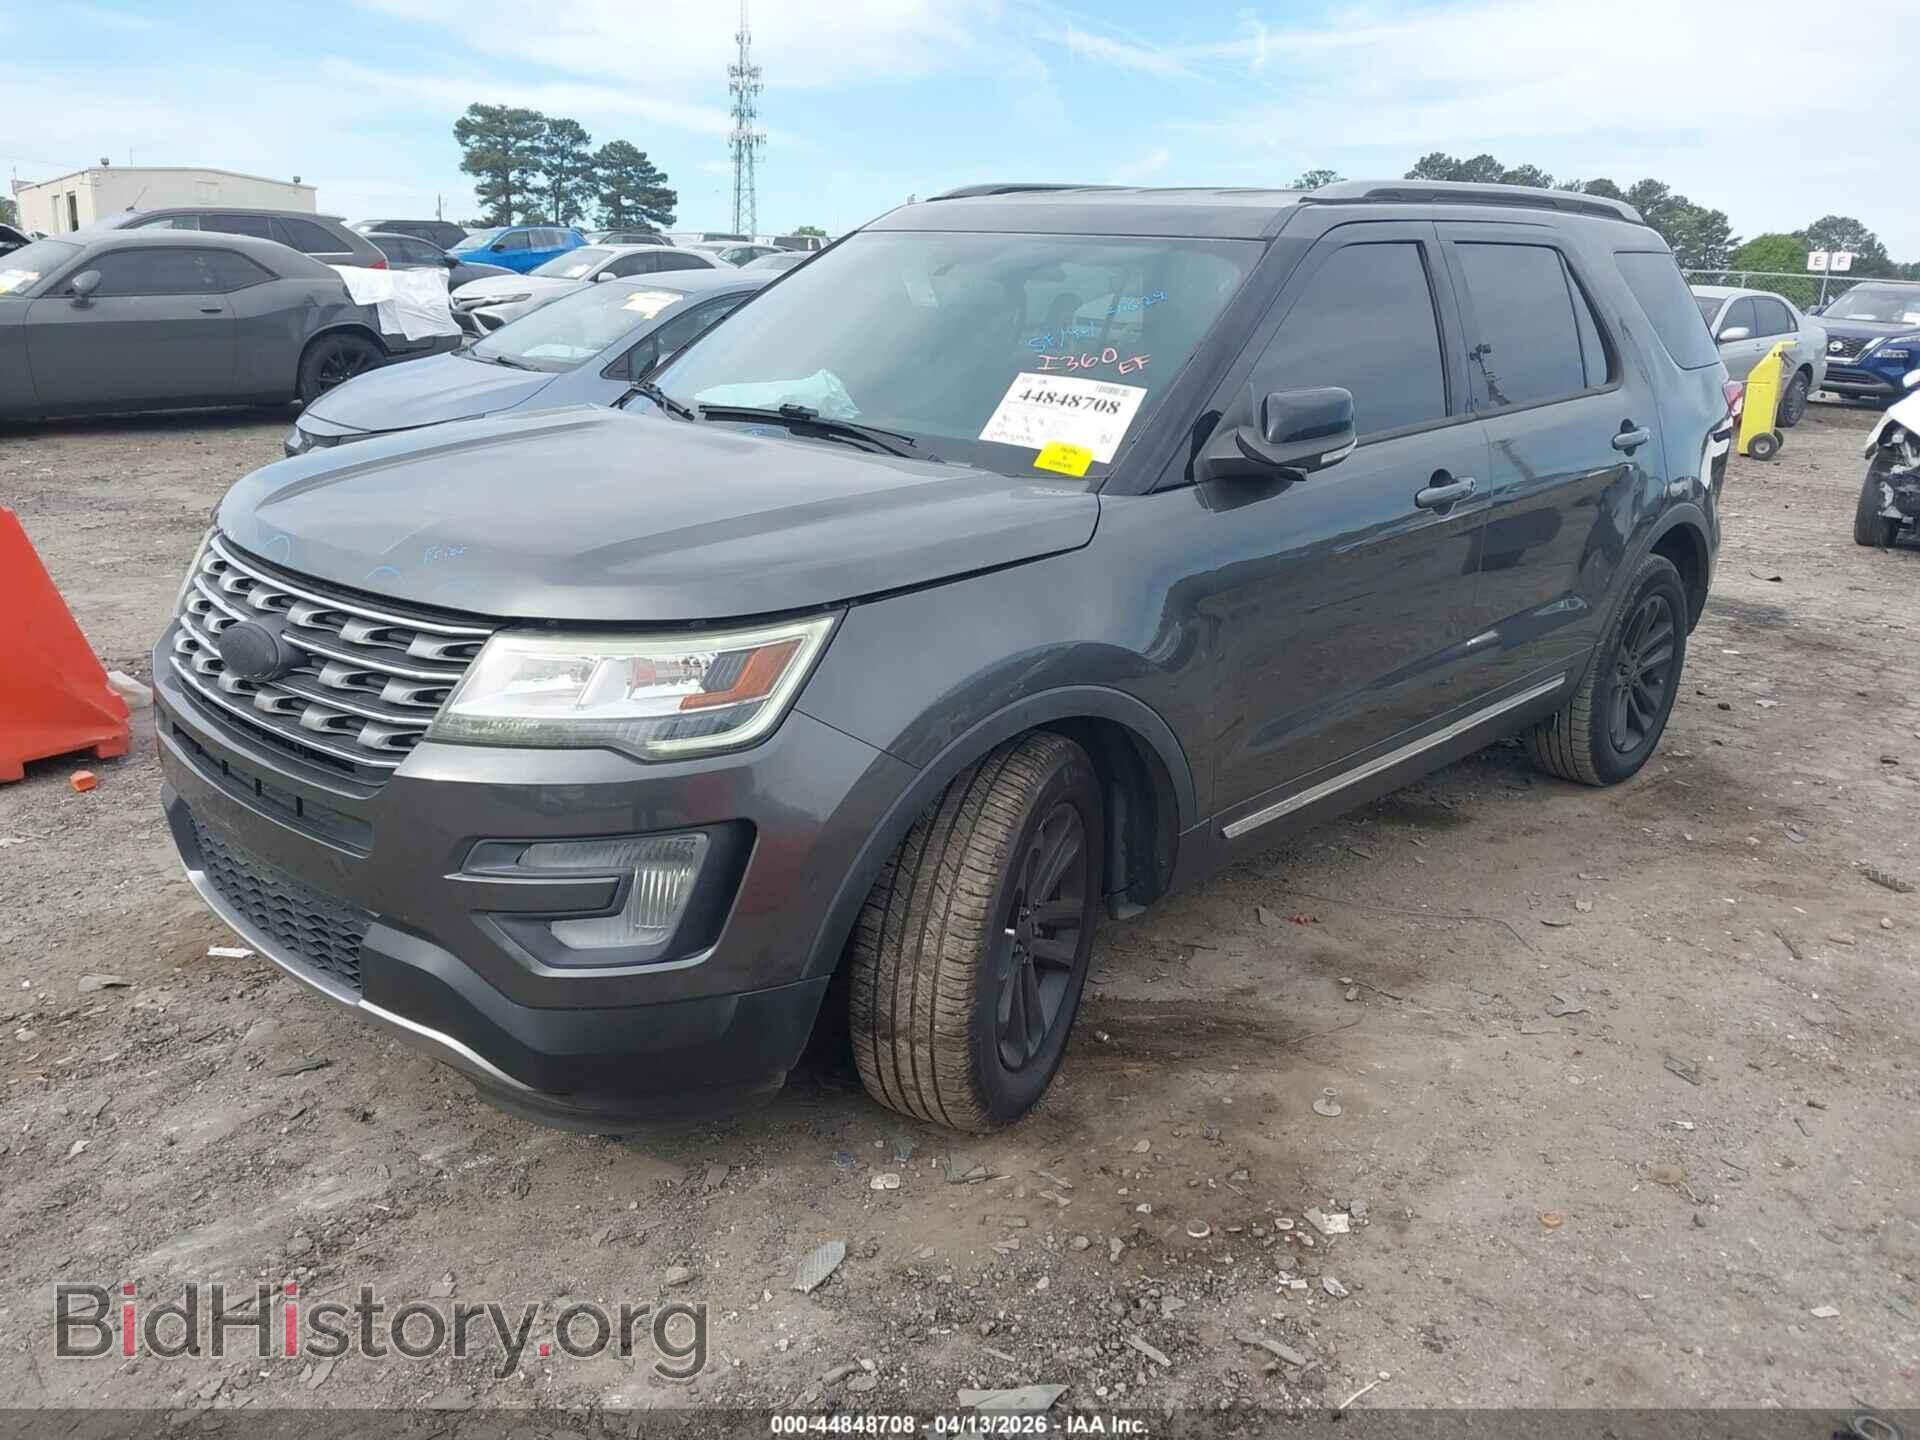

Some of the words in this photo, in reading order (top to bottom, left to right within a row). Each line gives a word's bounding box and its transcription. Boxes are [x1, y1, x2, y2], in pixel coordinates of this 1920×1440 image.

[1814, 256, 1822, 266] E
[1837, 256, 1846, 266] F
[1118, 354, 1152, 375] EF
[1018, 388, 1121, 415] 44848708
